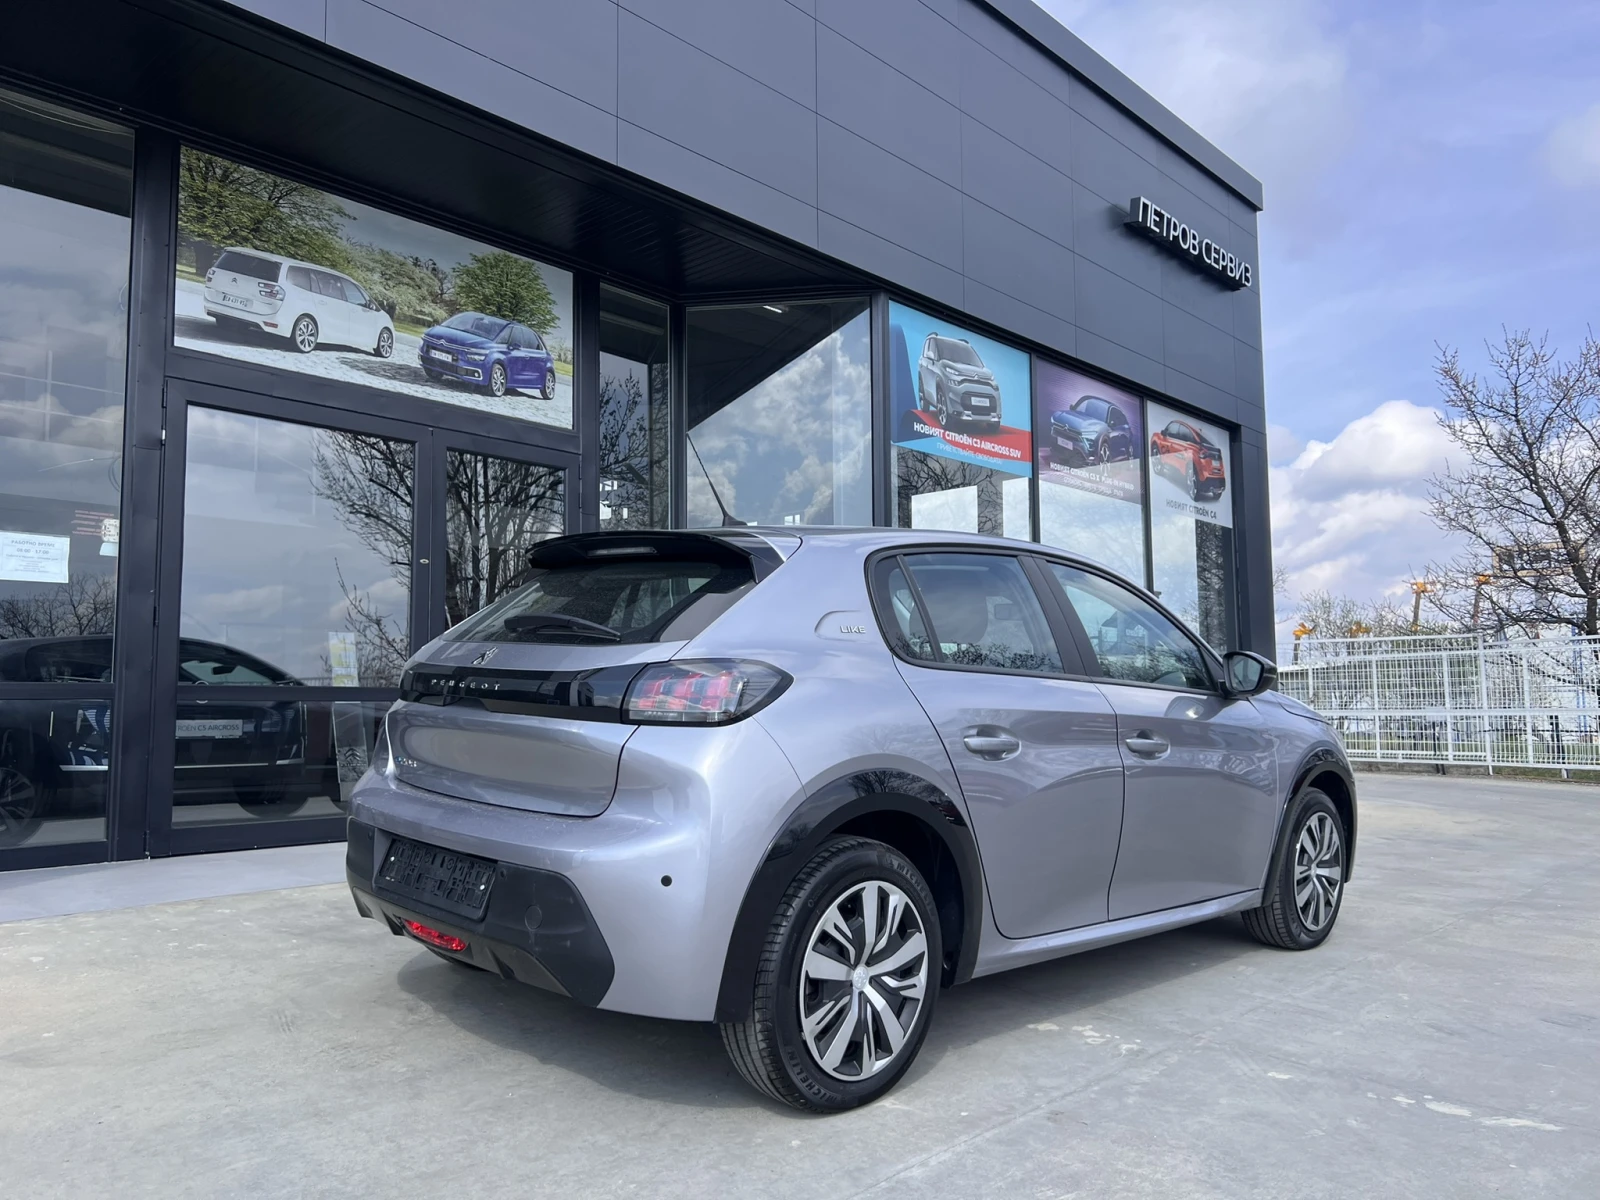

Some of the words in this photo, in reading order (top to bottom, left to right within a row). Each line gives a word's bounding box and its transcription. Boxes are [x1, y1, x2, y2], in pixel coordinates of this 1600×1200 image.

[1138, 196, 1199, 256] ПЕТРОВ
[1201, 238, 1252, 287] СЕРВИЗ
[913, 421, 945, 438] НОВИЯТ
[945, 430, 972, 446] CITROËN
[972, 438, 981, 448] C3
[980, 440, 1009, 456] AIRCROSS
[1009, 447, 1021, 459] SUV
[1165, 498, 1188, 512] НОВИЯТ
[1188, 504, 1210, 518] CITROËN
[1209, 510, 1217, 519] C4
[840, 625, 866, 634] LIKE
[431, 679, 500, 690] PEUGEOT
[197, 724, 207, 732] C5
[207, 723, 240, 731] AIRCROSS
